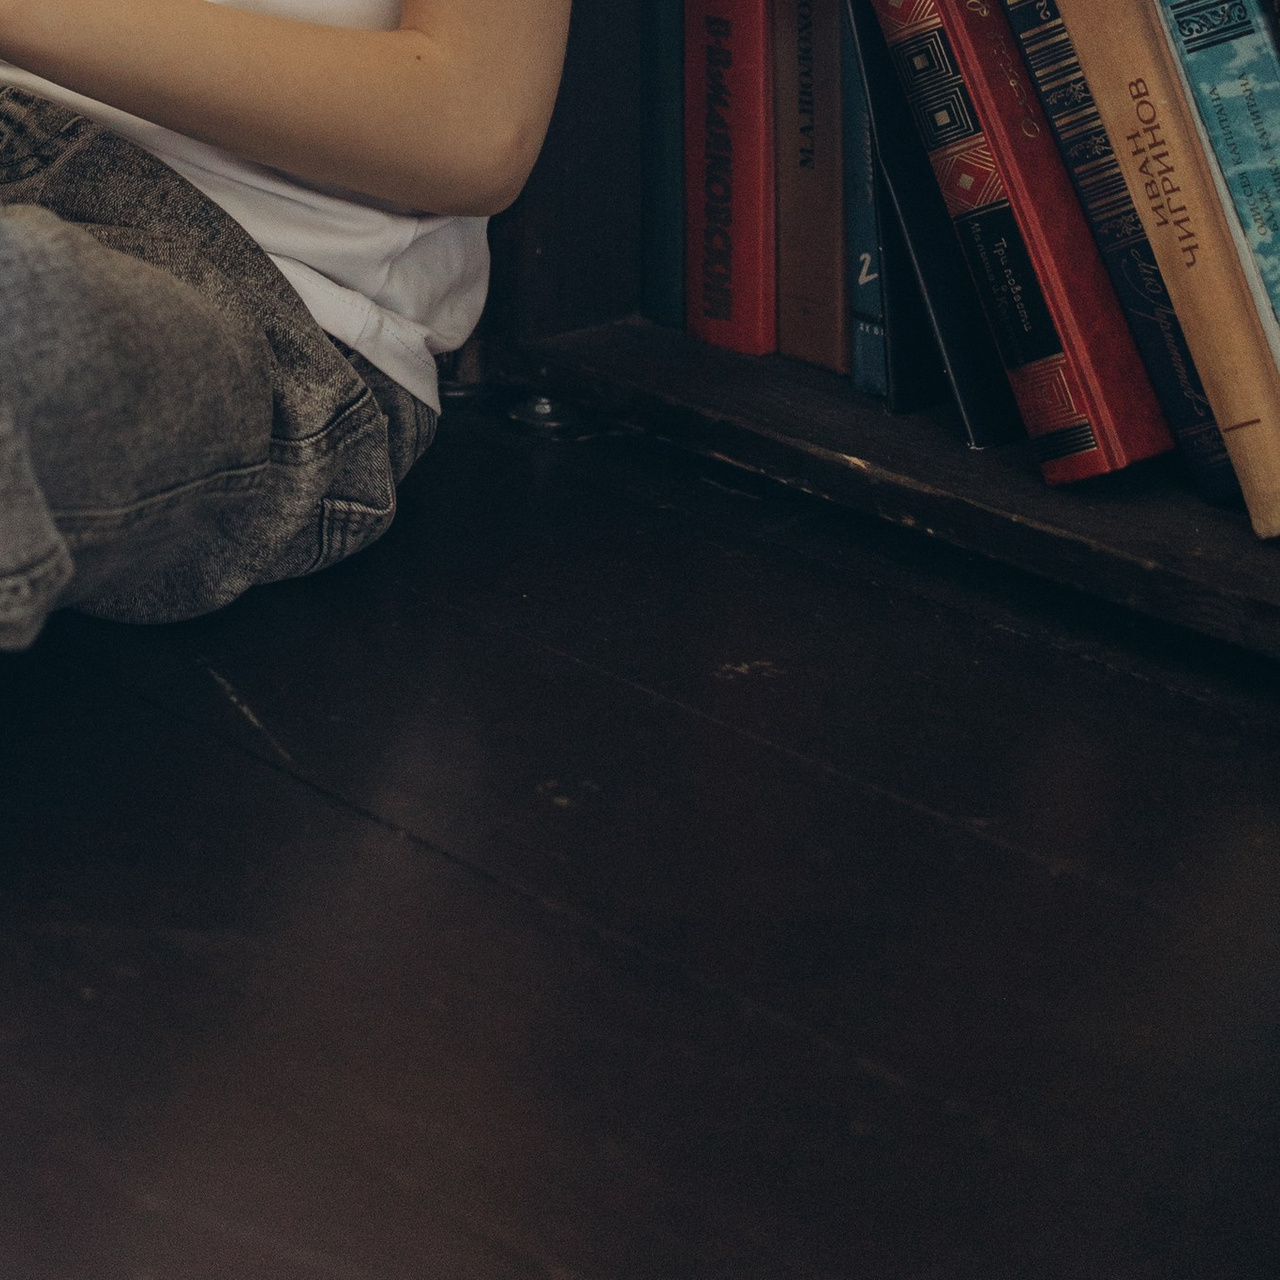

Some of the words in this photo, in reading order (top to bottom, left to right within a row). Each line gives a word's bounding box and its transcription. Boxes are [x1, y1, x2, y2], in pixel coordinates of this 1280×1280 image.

[1209, 86, 1243, 167] КАПИТАНА
[1237, 70, 1272, 152] КАПИТАНА
[1126, 130, 1170, 228] ИВАН
[1127, 77, 1200, 269] ЧИГРИНОВ
[1237, 171, 1267, 236] ОДИССЕЯ
[857, 251, 880, 286] 2
[993, 237, 1009, 266] Три
[1004, 267, 1033, 333] повести
